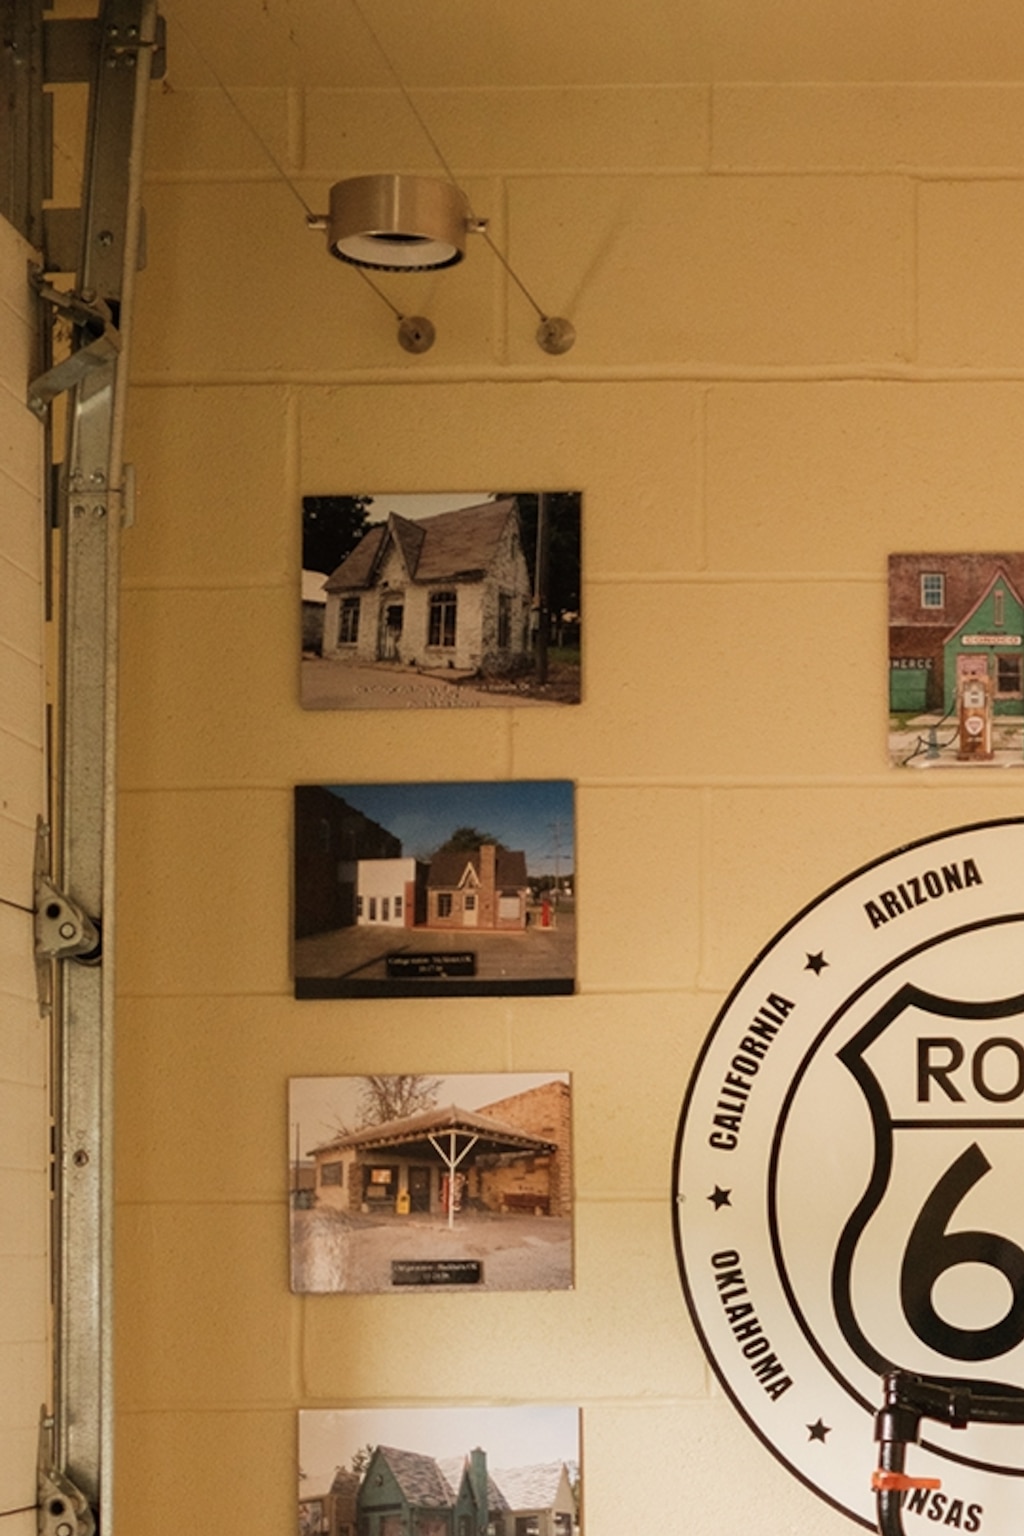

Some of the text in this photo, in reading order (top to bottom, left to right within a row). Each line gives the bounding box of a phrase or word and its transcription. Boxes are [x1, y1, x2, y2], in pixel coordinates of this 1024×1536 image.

[863, 858, 983, 929] ARIZONA
[709, 993, 796, 1151] CALIFORNIA
[711, 1249, 794, 1402] OKLAHOMA
[904, 1487, 984, 1533] NSAS
